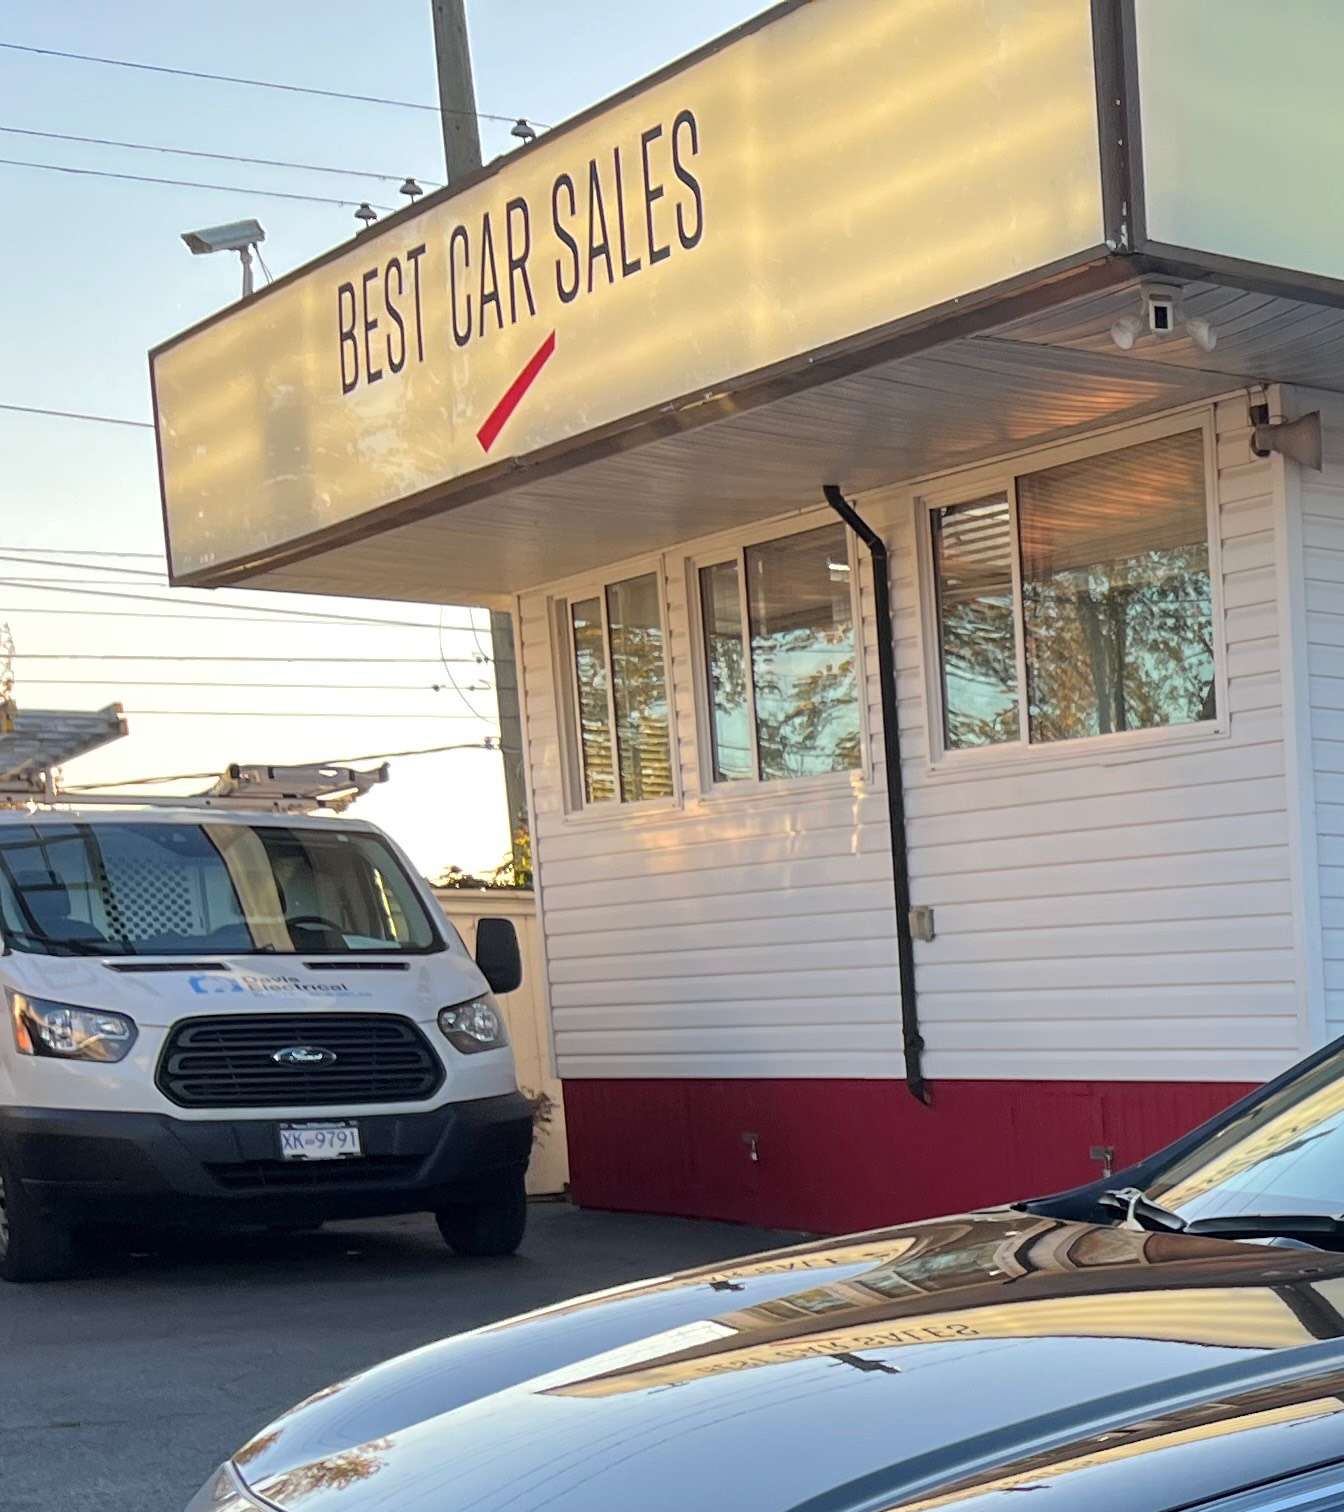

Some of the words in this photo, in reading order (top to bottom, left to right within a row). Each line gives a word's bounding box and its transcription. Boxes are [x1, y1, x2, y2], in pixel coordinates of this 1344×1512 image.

[337, 243, 427, 395] BEST
[449, 196, 536, 347] CAR
[551, 109, 704, 304] SALES
